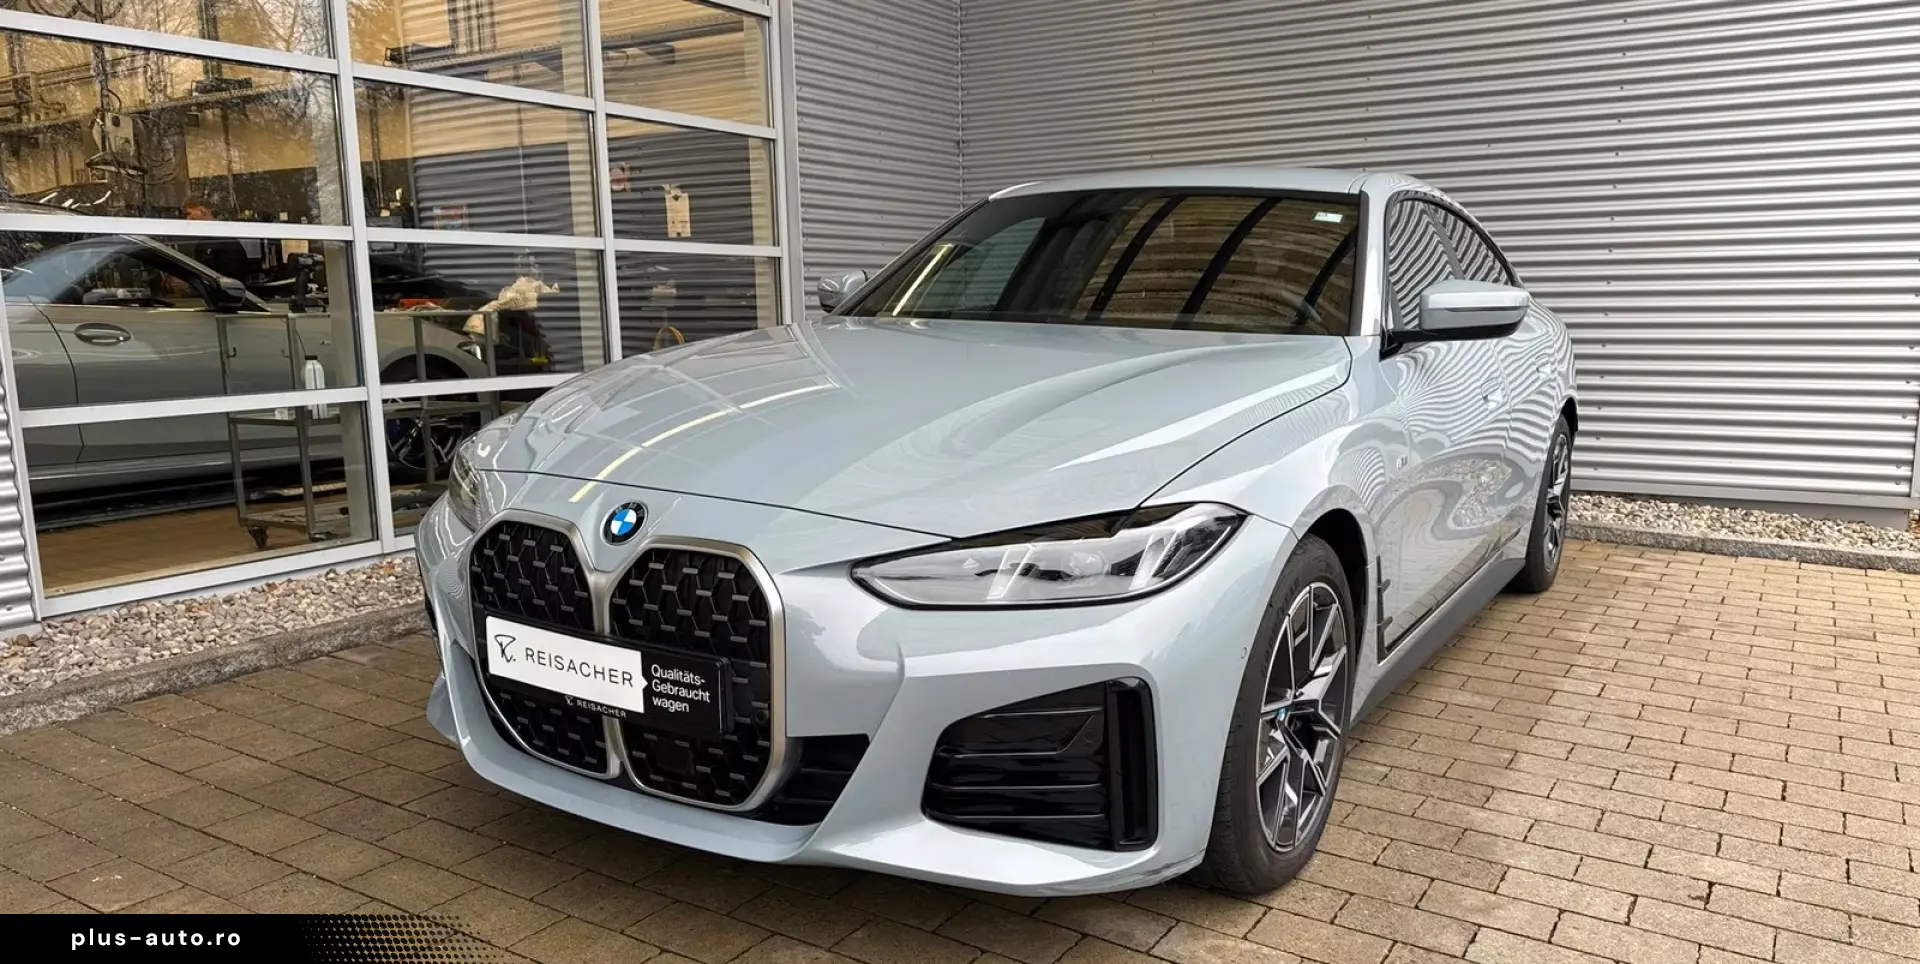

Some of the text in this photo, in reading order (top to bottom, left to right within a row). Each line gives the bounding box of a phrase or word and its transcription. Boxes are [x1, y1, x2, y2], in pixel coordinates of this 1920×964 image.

[525, 647, 633, 687] REISACHER
[651, 664, 706, 685] Qualitäts-
[652, 679, 711, 703] Gebraucht
[576, 699, 628, 718] REISACHER
[652, 696, 690, 713] wagen
